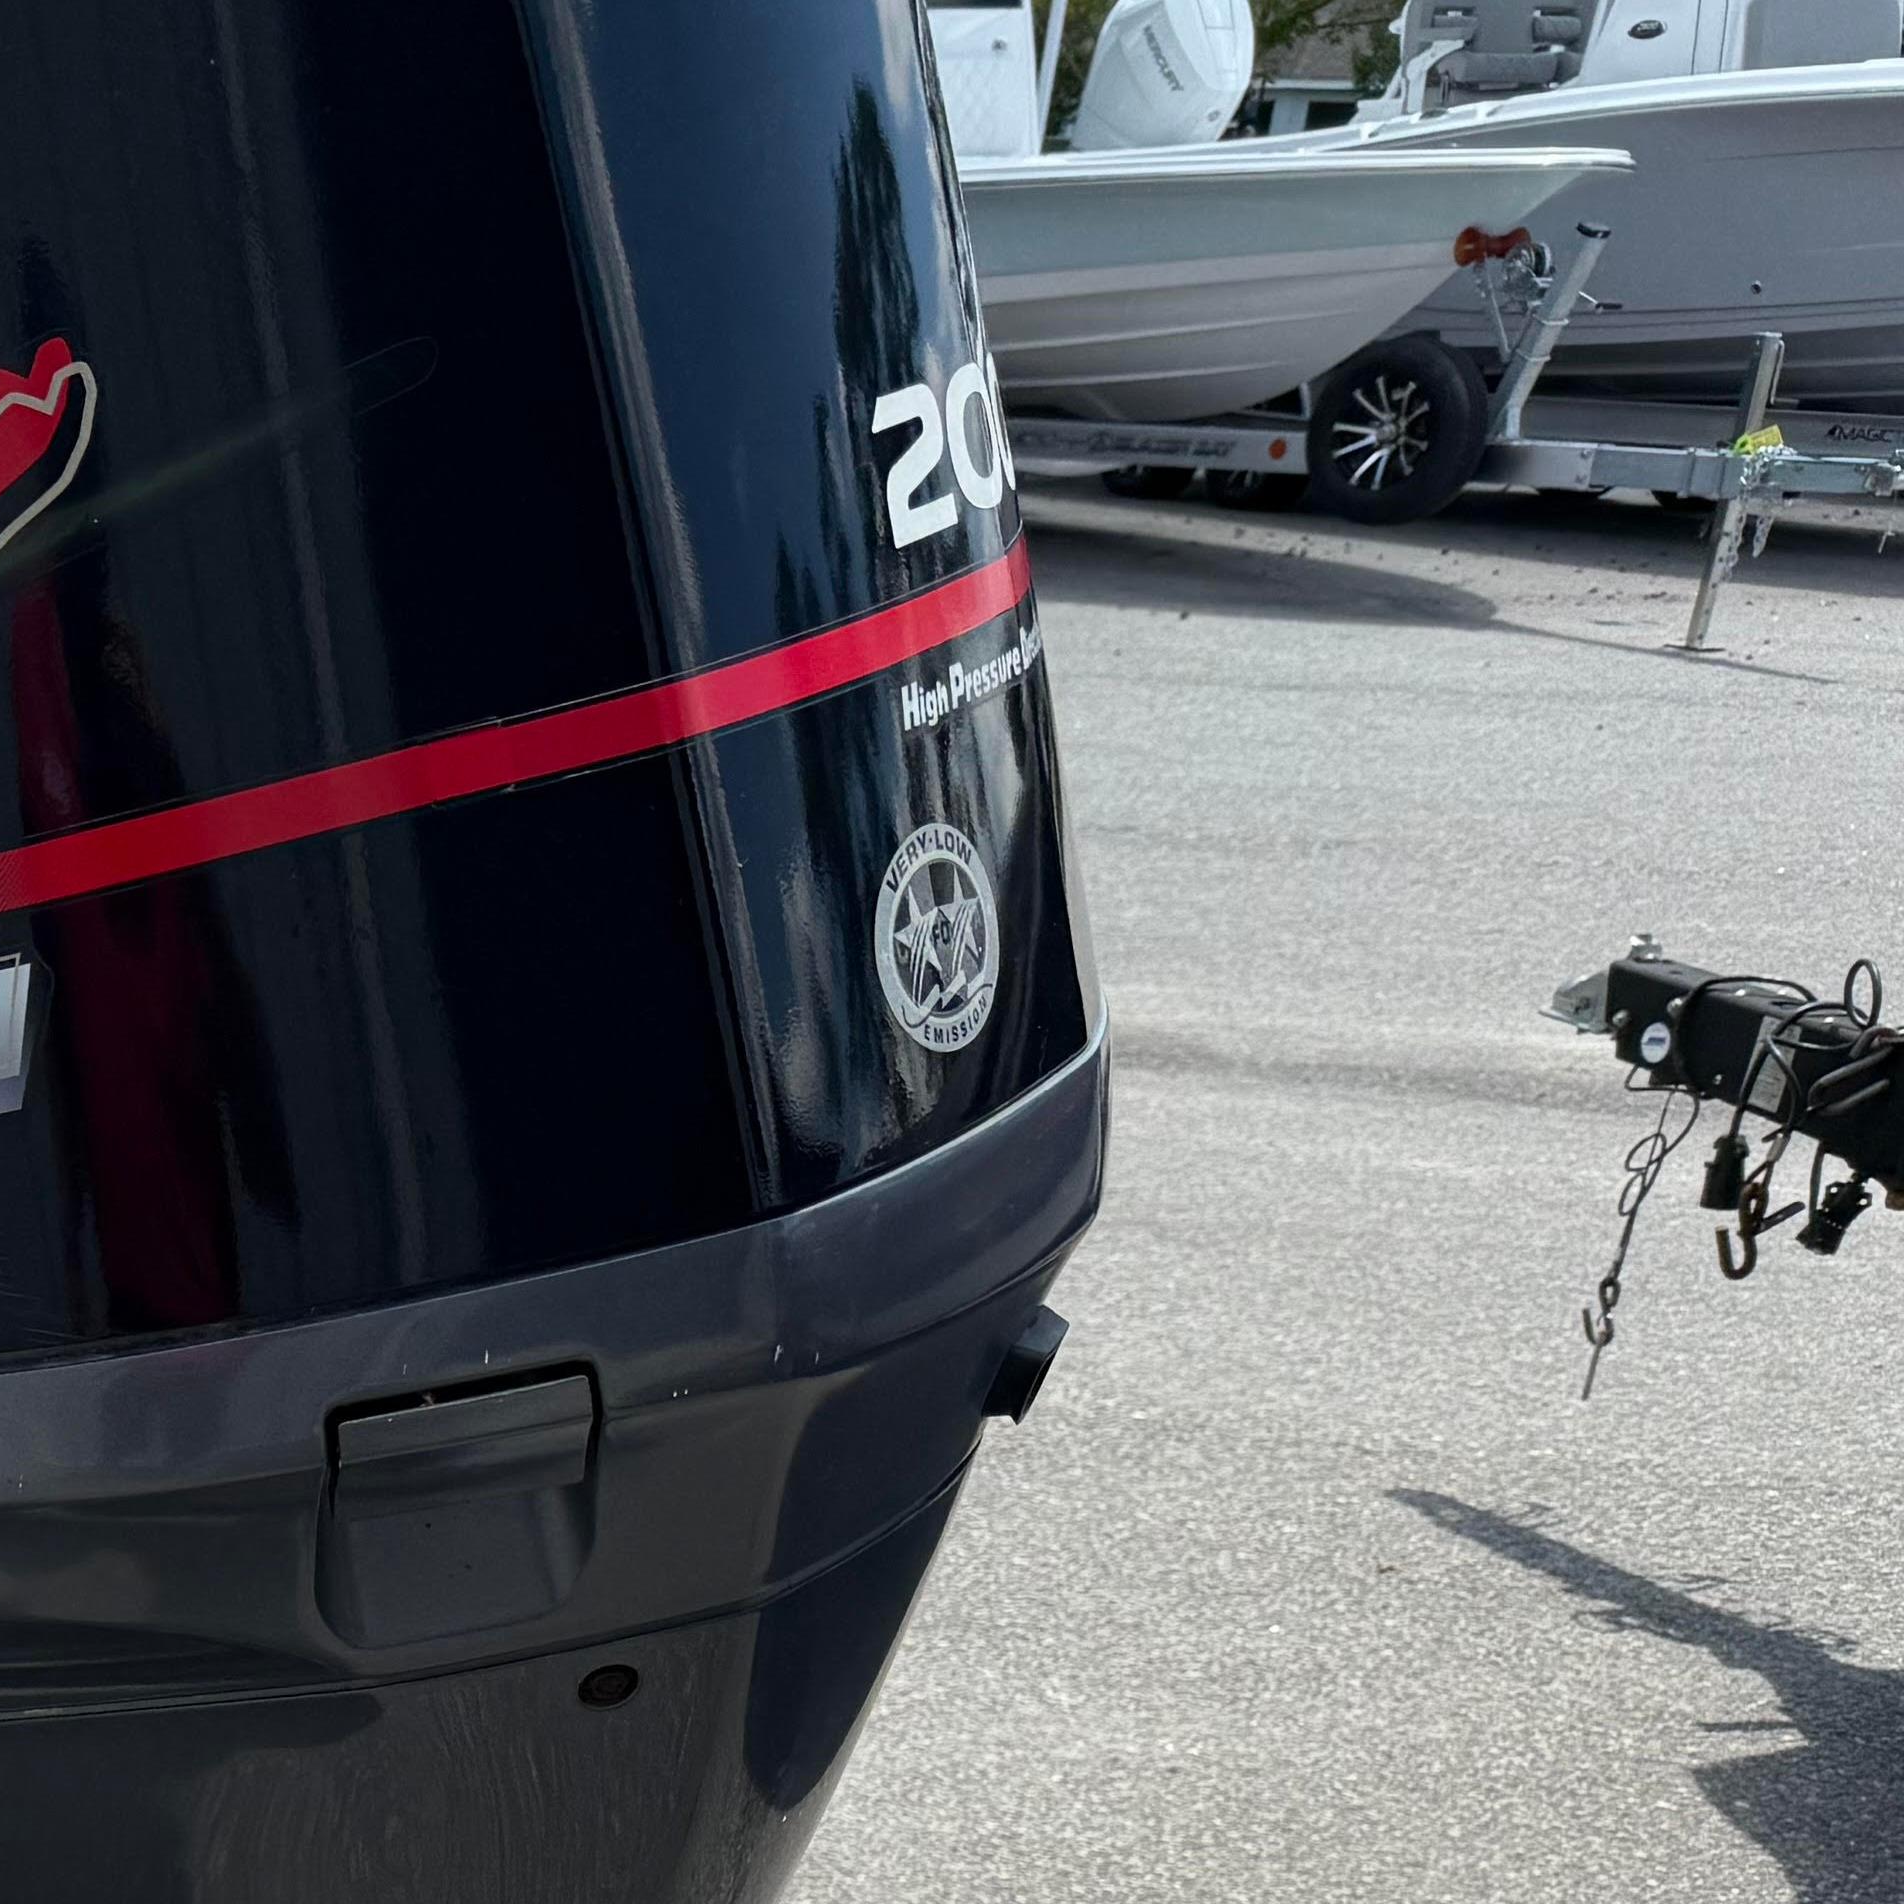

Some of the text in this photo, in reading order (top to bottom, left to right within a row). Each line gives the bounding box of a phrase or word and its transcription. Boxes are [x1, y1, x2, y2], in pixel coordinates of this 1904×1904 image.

[901, 680, 950, 732] High
[948, 646, 1022, 710] Pressure
[923, 995, 987, 1046] EMISSION
